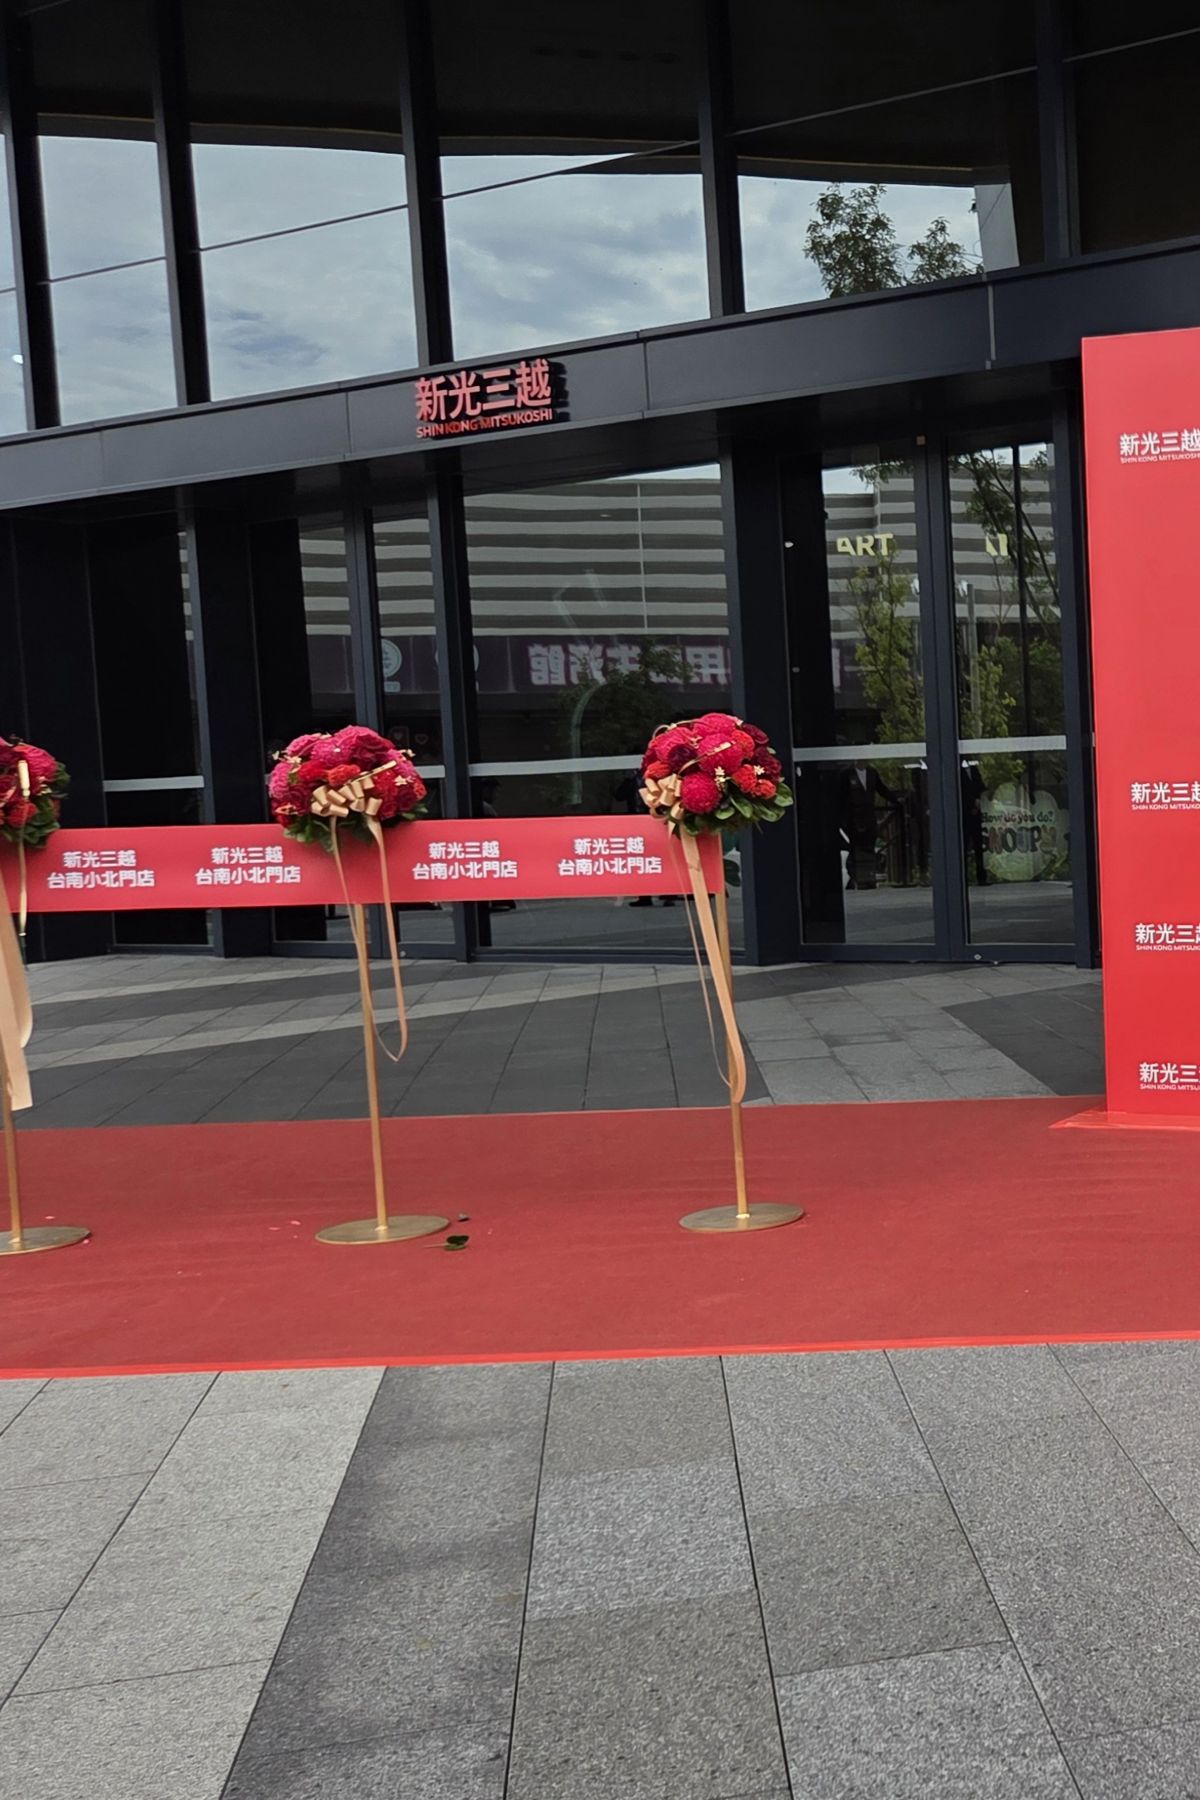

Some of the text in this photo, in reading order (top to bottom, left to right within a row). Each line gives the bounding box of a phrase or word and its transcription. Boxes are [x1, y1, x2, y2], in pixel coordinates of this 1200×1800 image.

[415, 358, 552, 421] 新光三越
[416, 408, 553, 438] SHIN KONG MITSUKOSHI
[1120, 428, 1200, 455] 新光三越
[1158, 453, 1200, 461] MITSUKOSHI
[837, 533, 893, 556] ART
[211, 846, 284, 864] 新光三越
[428, 840, 500, 859] 新光三越
[573, 837, 645, 856] 新光三越
[63, 850, 137, 868] 新光三越
[558, 857, 662, 876] 台南小北門店
[47, 869, 155, 889] 台南小北門店
[195, 866, 301, 885] 台南小北門店
[412, 861, 518, 880] 台南小北門店
